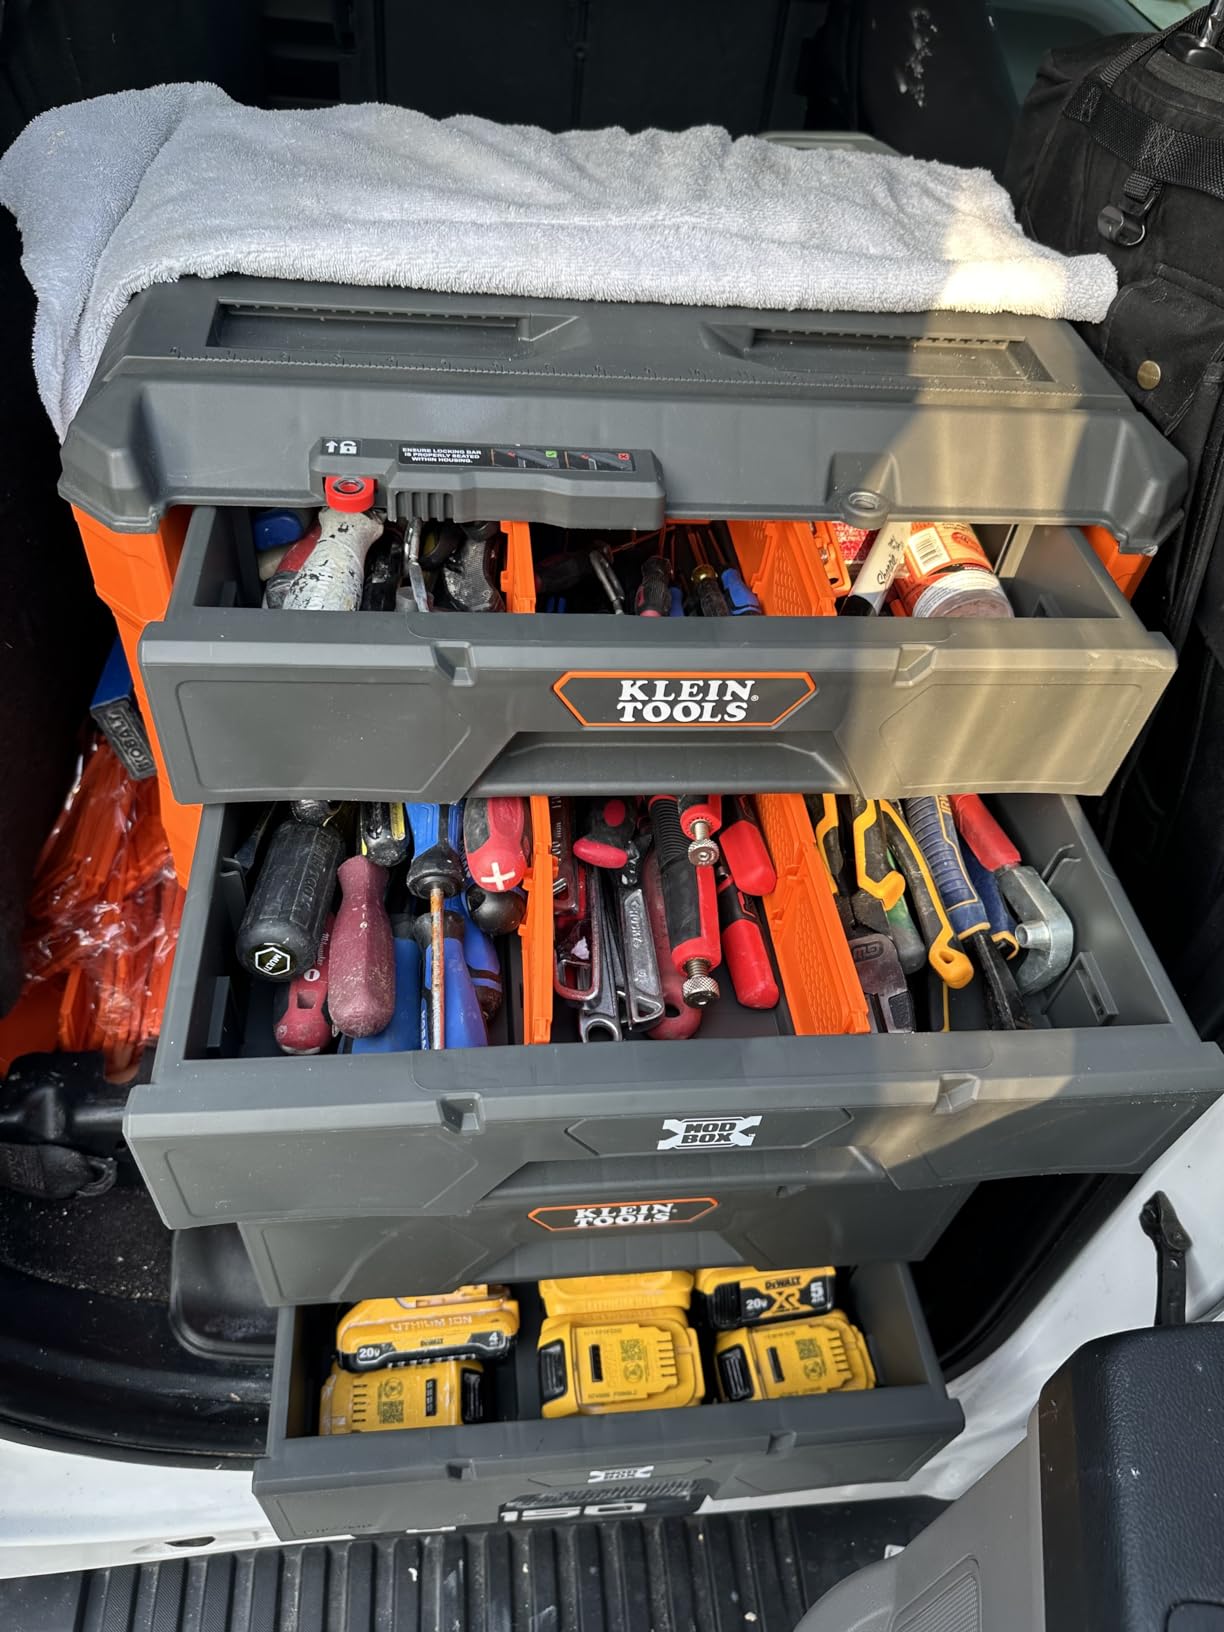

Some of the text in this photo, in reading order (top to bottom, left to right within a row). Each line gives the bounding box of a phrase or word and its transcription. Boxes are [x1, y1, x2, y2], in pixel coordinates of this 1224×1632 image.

[616, 701, 748, 722] TOOLS
[107, 710, 152, 769] KOBALT
[684, 1122, 737, 1134] MOD
[681, 1132, 735, 1144] BOX
[575, 1203, 675, 1219] KLEIN
[574, 1212, 671, 1228] TOOLS
[810, 1281, 825, 1298] 5
[391, 1315, 473, 1332] LITHIUM ION
